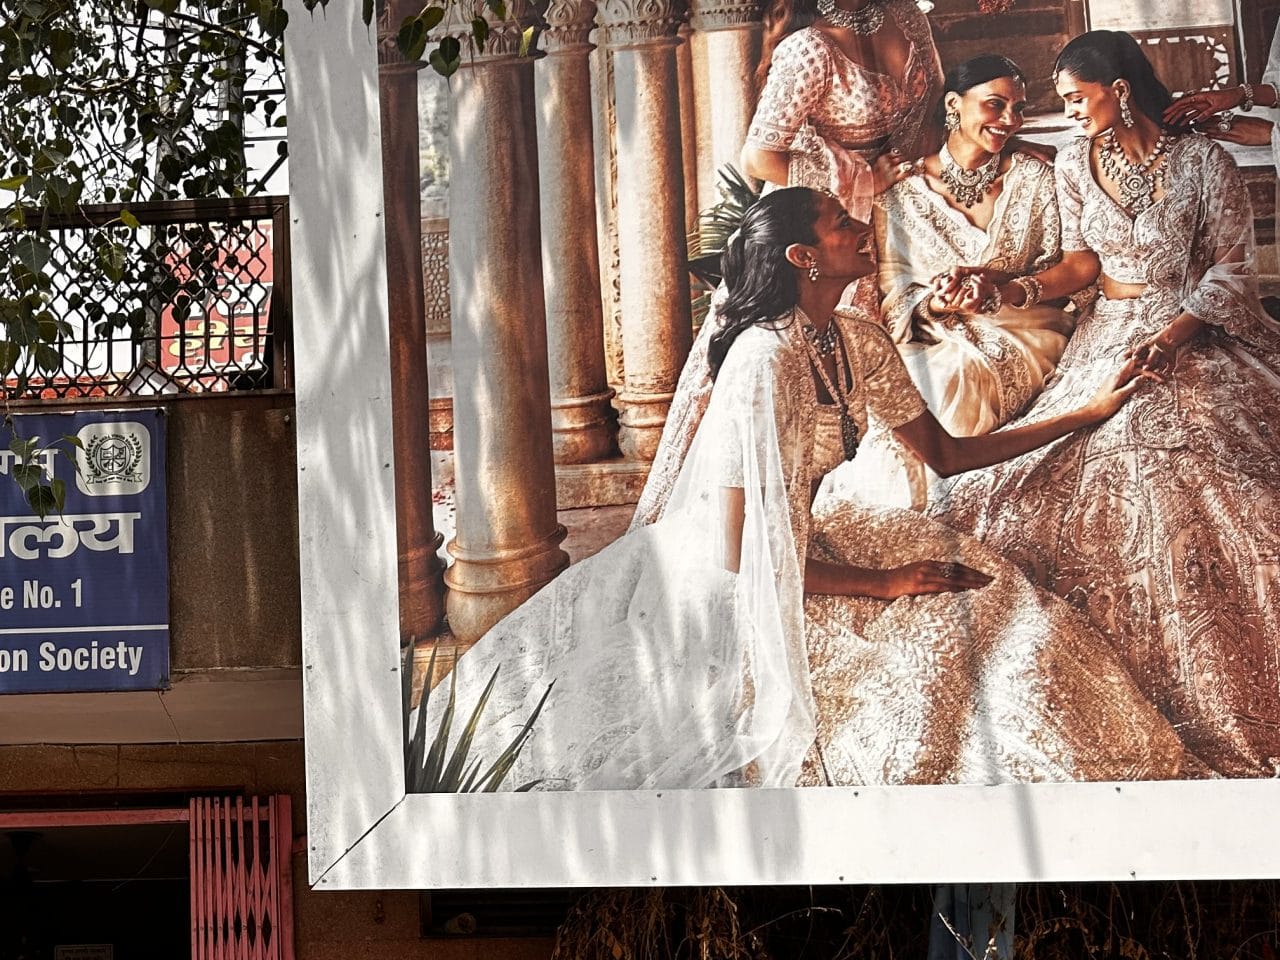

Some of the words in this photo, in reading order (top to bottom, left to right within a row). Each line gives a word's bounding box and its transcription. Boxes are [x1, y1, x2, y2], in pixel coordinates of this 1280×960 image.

[23, 580, 62, 609] No.
[70, 578, 82, 608] 1
[39, 640, 143, 676] Society
